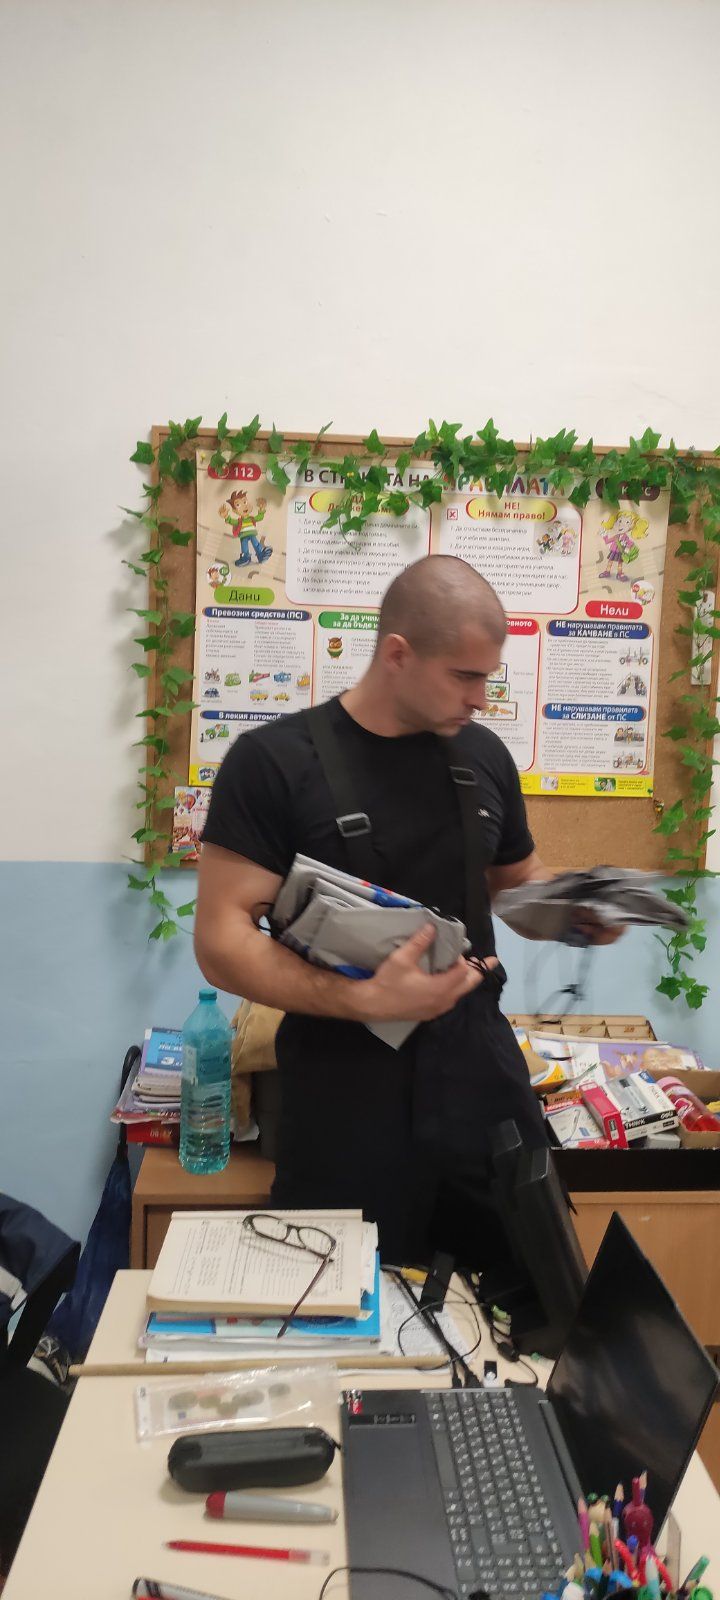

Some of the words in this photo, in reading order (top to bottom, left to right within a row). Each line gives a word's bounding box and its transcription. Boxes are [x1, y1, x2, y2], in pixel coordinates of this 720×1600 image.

[233, 467, 254, 478] 112
[304, 469, 314, 483] В
[504, 502, 520, 510] НЕ!
[478, 510, 511, 519] Нямам
[513, 512, 546, 521] право!
[228, 590, 260, 602] Дани
[211, 608, 250, 618] Превозни
[251, 611, 285, 619] средства
[286, 611, 303, 620] (ПС)
[600, 604, 629, 616] Нели
[340, 613, 349, 621] За
[350, 614, 360, 622] да
[567, 622, 607, 630] нарушавам
[607, 623, 643, 631] правилата
[577, 629, 613, 638] КАЧВАНЕ
[219, 711, 224, 719] В
[602, 707, 639, 715] правилата
[570, 712, 606, 720] СЛИЗАНЕ
